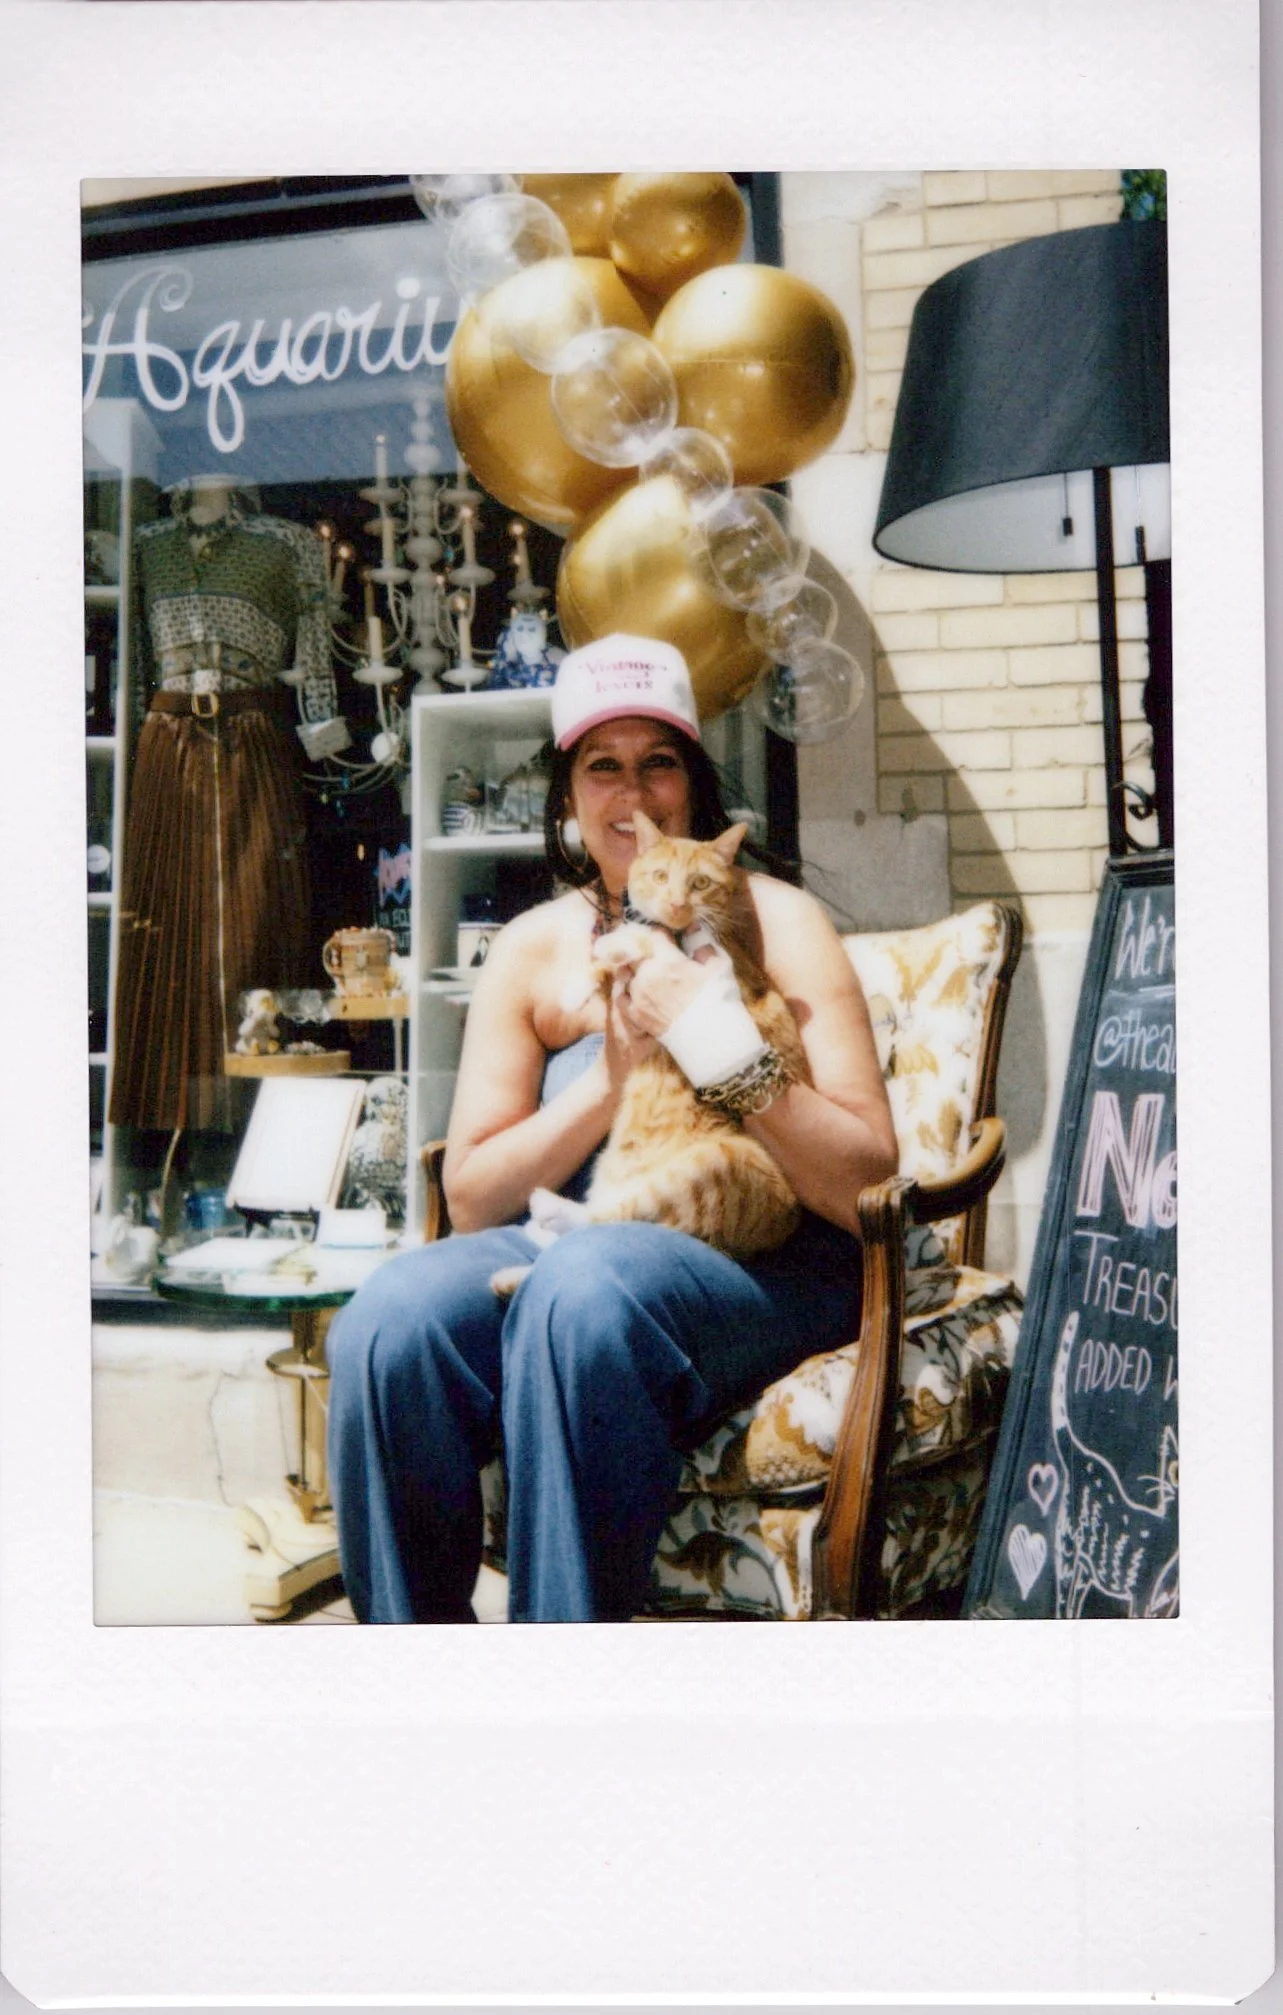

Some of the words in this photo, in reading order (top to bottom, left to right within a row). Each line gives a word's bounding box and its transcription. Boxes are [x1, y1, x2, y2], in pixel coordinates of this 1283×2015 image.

[1115, 895, 1176, 980] We'r
[1093, 1008, 1177, 1075] @thea
[1074, 1338, 1153, 1396] ADDED
